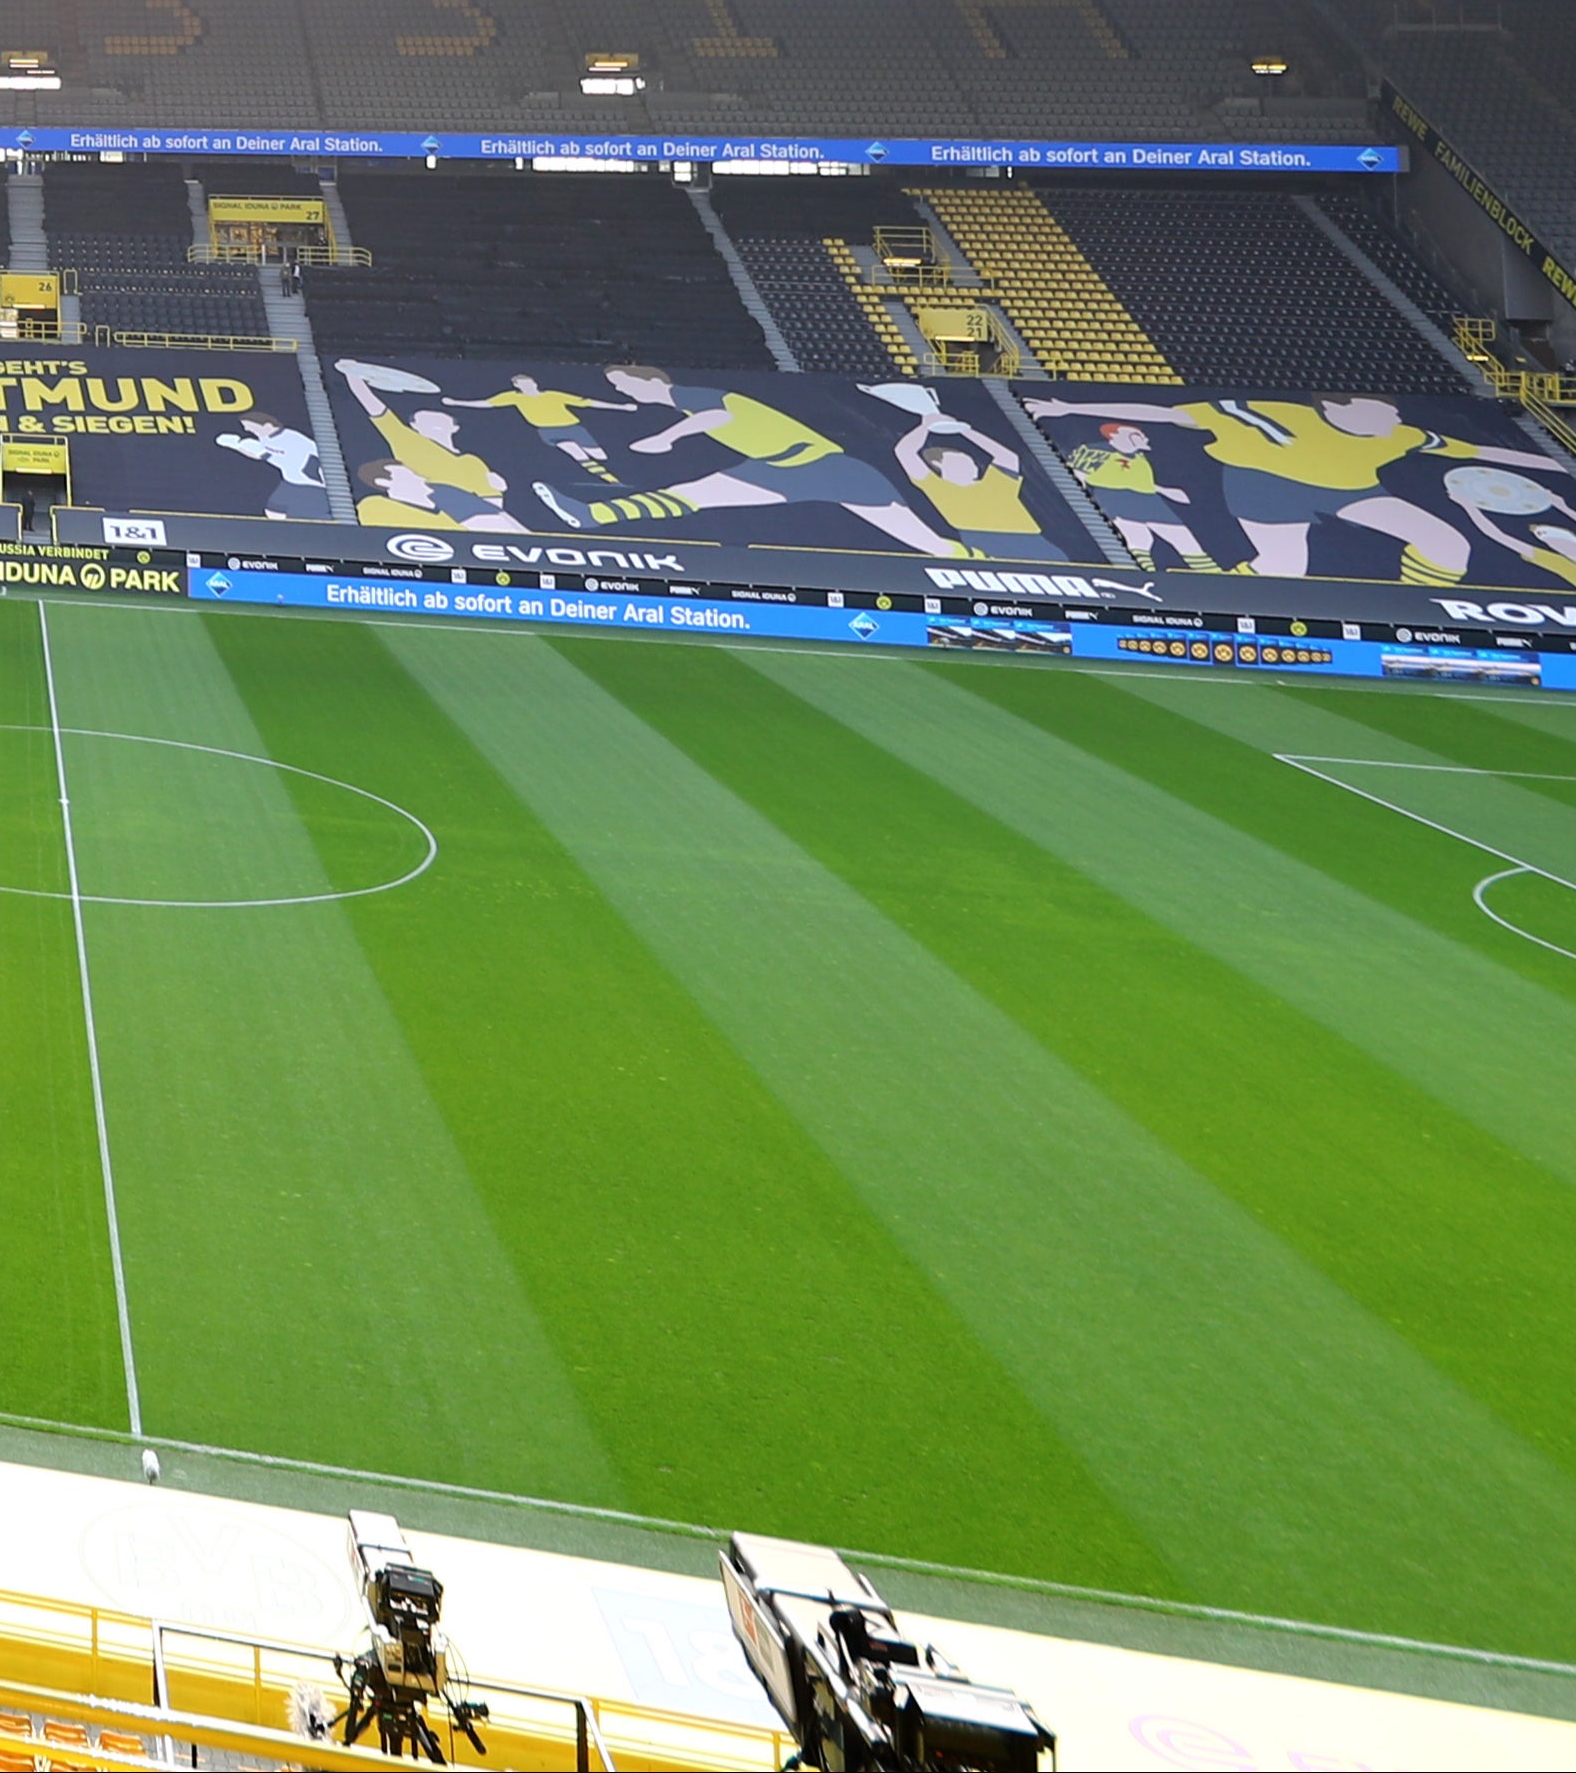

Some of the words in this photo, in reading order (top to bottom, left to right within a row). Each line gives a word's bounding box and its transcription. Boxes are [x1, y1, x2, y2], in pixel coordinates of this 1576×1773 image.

[70, 133, 139, 148] Erhältlich
[142, 134, 161, 148] ab
[165, 134, 209, 149] sofort
[213, 137, 231, 149] an
[236, 136, 285, 150] Deiner
[289, 136, 319, 151] Aral
[325, 137, 383, 152] Station.
[481, 140, 555, 155] Erhältlich
[560, 140, 580, 155] ab
[585, 141, 631, 156] sofort
[637, 144, 657, 156] an
[663, 142, 716, 157] Deiner
[722, 142, 755, 158] Aral
[760, 143, 824, 158] Station.
[931, 146, 1013, 162] Erhältlich
[1019, 147, 1041, 163] ab
[1046, 147, 1099, 163] sofort
[1105, 150, 1127, 164] an
[1133, 148, 1192, 165] Deiner
[1197, 149, 1234, 165] Aral
[1239, 149, 1311, 166] Station.
[1434, 140, 1534, 255] FAMILIENBLOCK
[306, 211, 319, 220] 27
[39, 282, 52, 292] 26
[966, 315, 983, 325] 22
[18, 415, 46, 434] &
[52, 416, 197, 434] SIEGEN!
[109, 525, 158, 540] 1&1
[37, 545, 110, 560] VERBINDET
[471, 544, 685, 572] EVONIK
[110, 567, 180, 592] PARK
[601, 581, 639, 592] EVONIK
[924, 567, 1100, 599] PUMA
[327, 584, 417, 607] Erhältlich
[423, 590, 448, 609] ab
[454, 593, 512, 613] sofort
[518, 601, 543, 616] an
[550, 599, 618, 621] Deiner
[623, 603, 664, 624] Aral
[670, 606, 751, 630] Station.
[990, 606, 1033, 617] EVONIK
[1415, 631, 1461, 644] EVONIK
